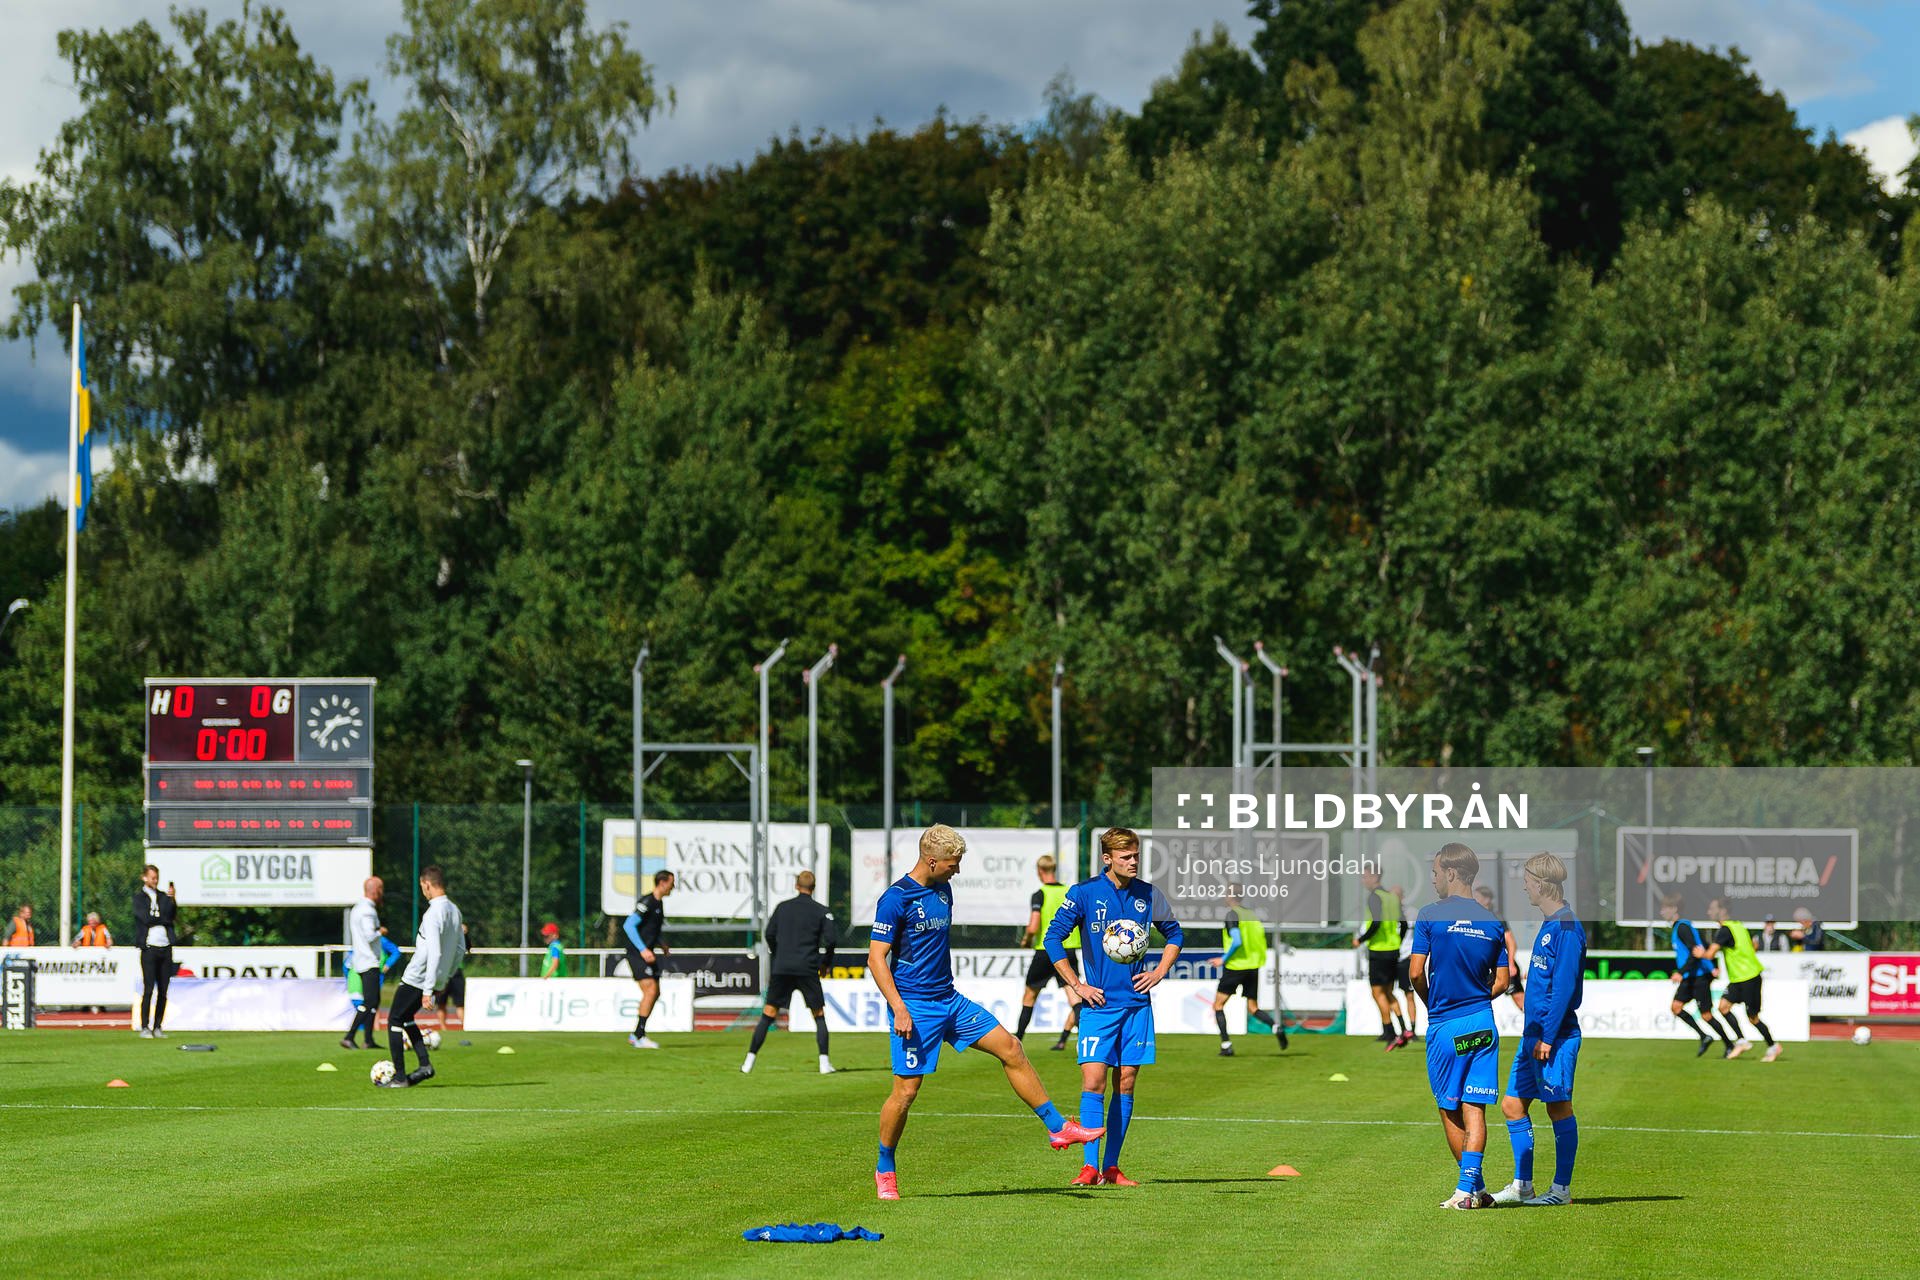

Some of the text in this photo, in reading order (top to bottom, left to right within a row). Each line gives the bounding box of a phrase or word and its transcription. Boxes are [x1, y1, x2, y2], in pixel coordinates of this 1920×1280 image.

[151, 689, 171, 715] H
[272, 689, 292, 714] G
[236, 854, 313, 880] BYGGA
[983, 855, 1026, 873] CITY
[1653, 855, 1820, 884] OPTIMERA
[917, 907, 925, 919] 5
[1095, 908, 1107, 920] 17
[1081, 1036, 1099, 1057] 17
[905, 1048, 918, 1069] 5
